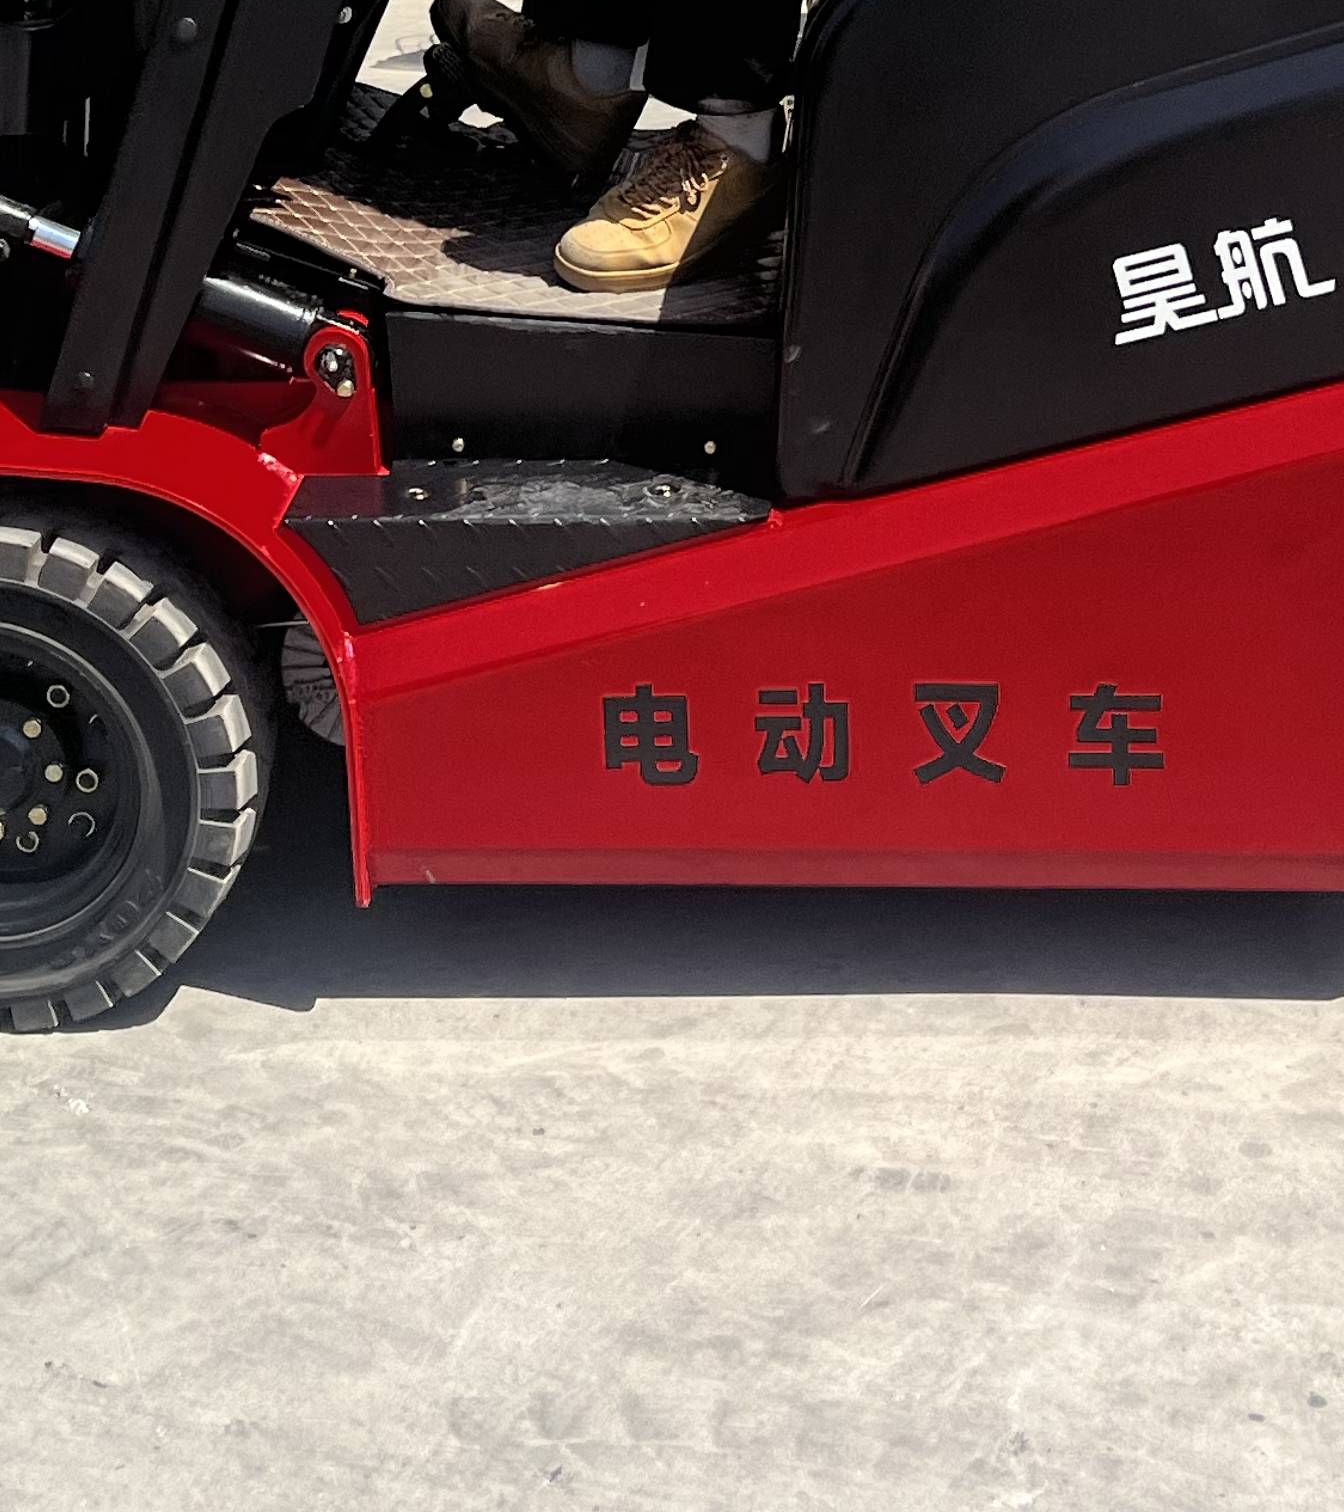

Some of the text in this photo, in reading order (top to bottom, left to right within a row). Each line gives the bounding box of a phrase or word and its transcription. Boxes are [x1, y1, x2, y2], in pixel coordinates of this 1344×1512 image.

[1112, 217, 1336, 346] 昊航
[602, 683, 1165, 786] 电动叉车
